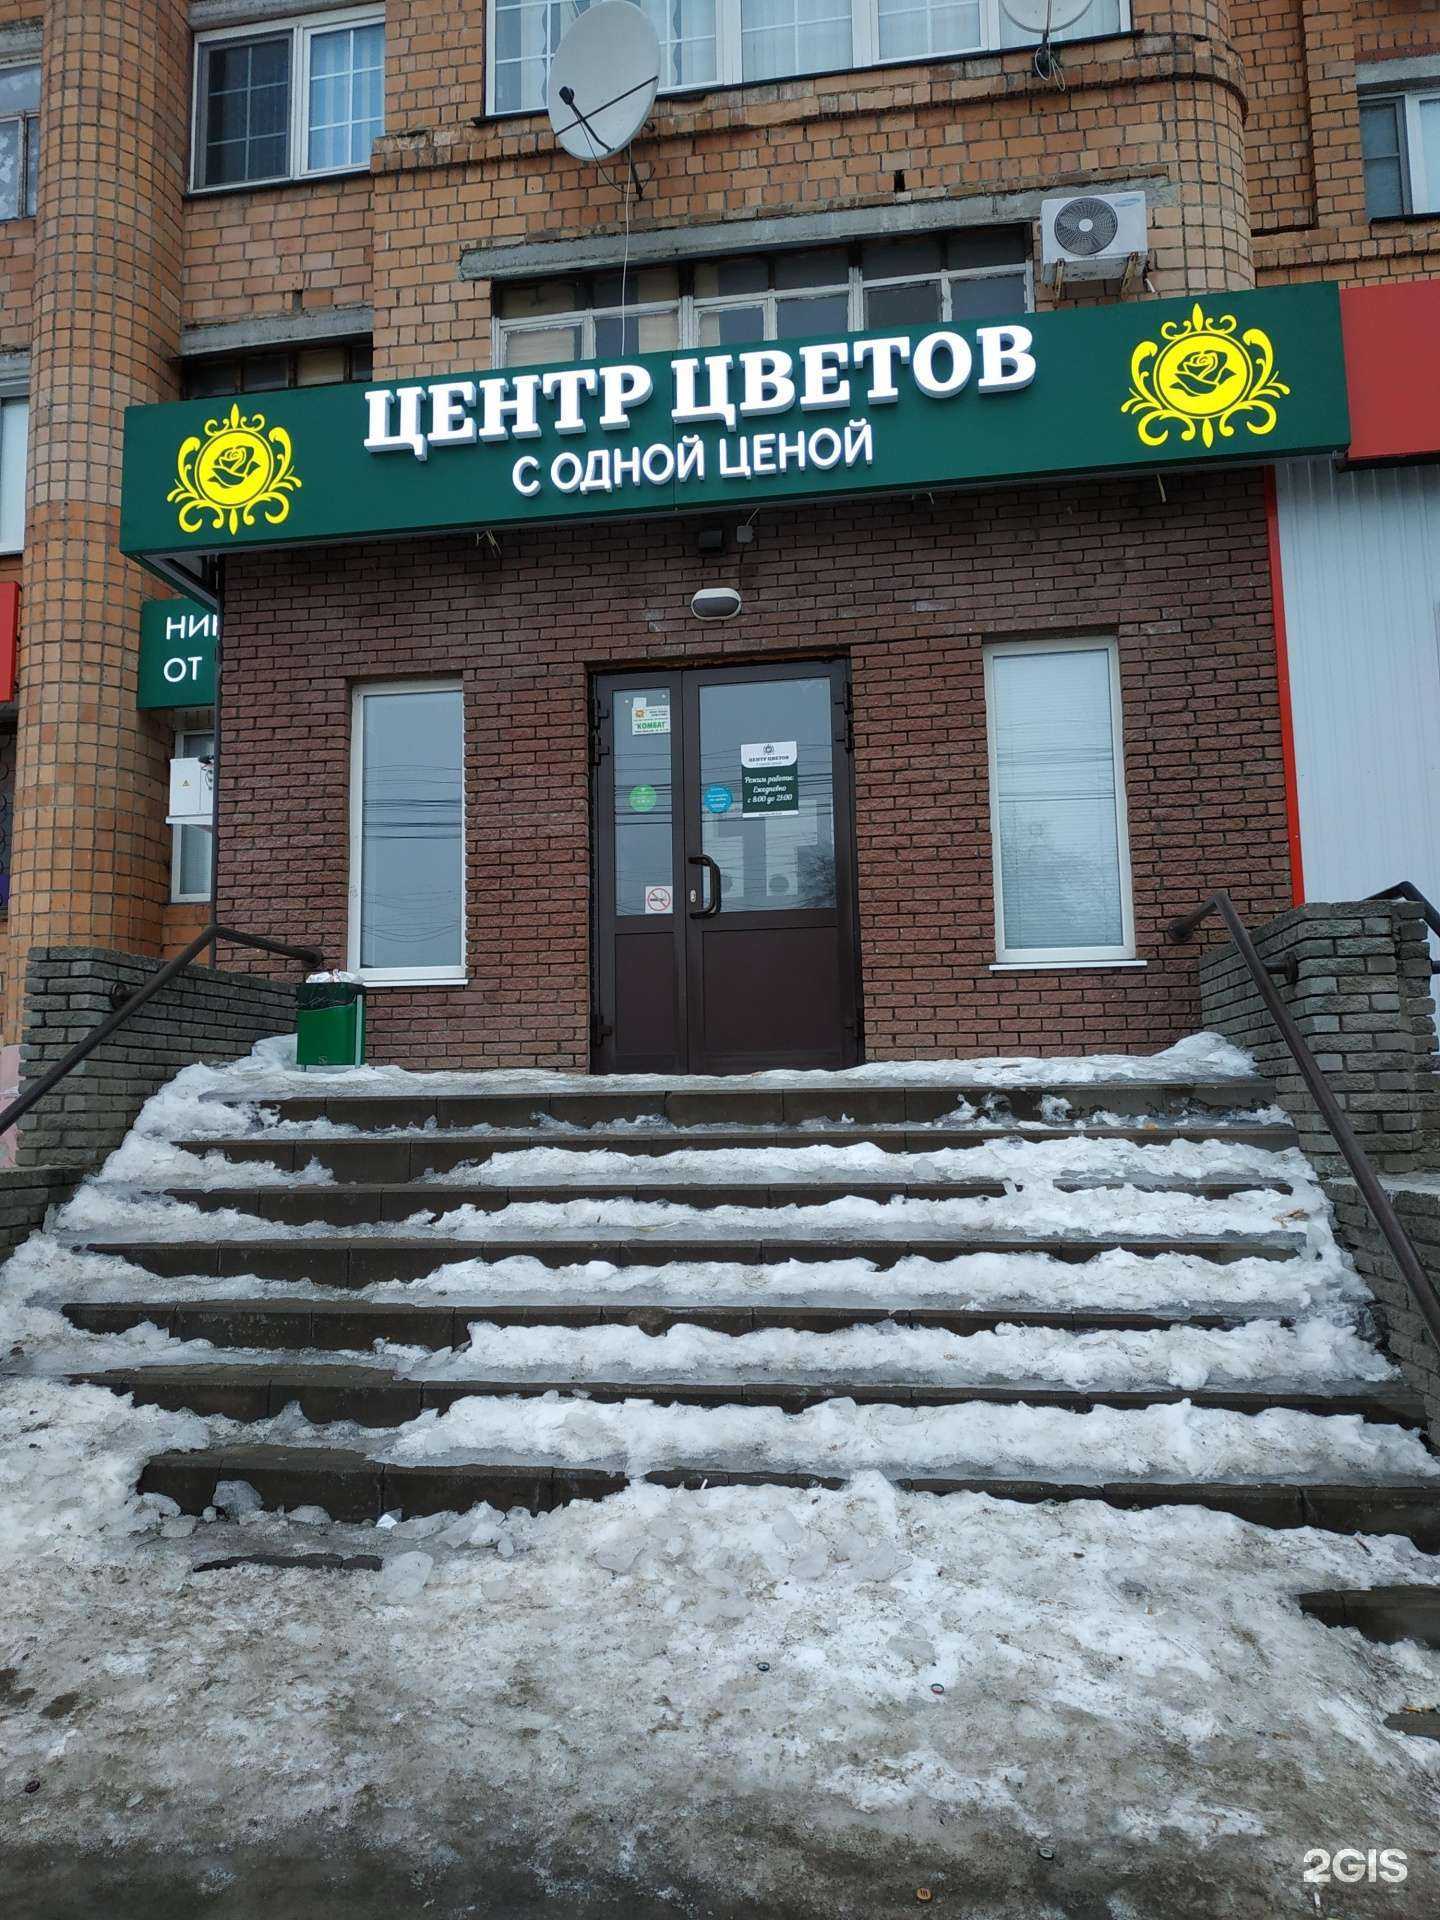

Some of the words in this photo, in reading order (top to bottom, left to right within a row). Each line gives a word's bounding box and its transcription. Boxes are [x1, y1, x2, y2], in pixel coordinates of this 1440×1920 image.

[364, 365, 653, 462] ЦЕНТР
[671, 325, 1036, 432] ЦВЕТОВ
[512, 456, 541, 497] С
[550, 434, 704, 494] ОДНОЙ
[719, 418, 873, 479] ЦЕНОЙ
[163, 656, 203, 683] ОТ
